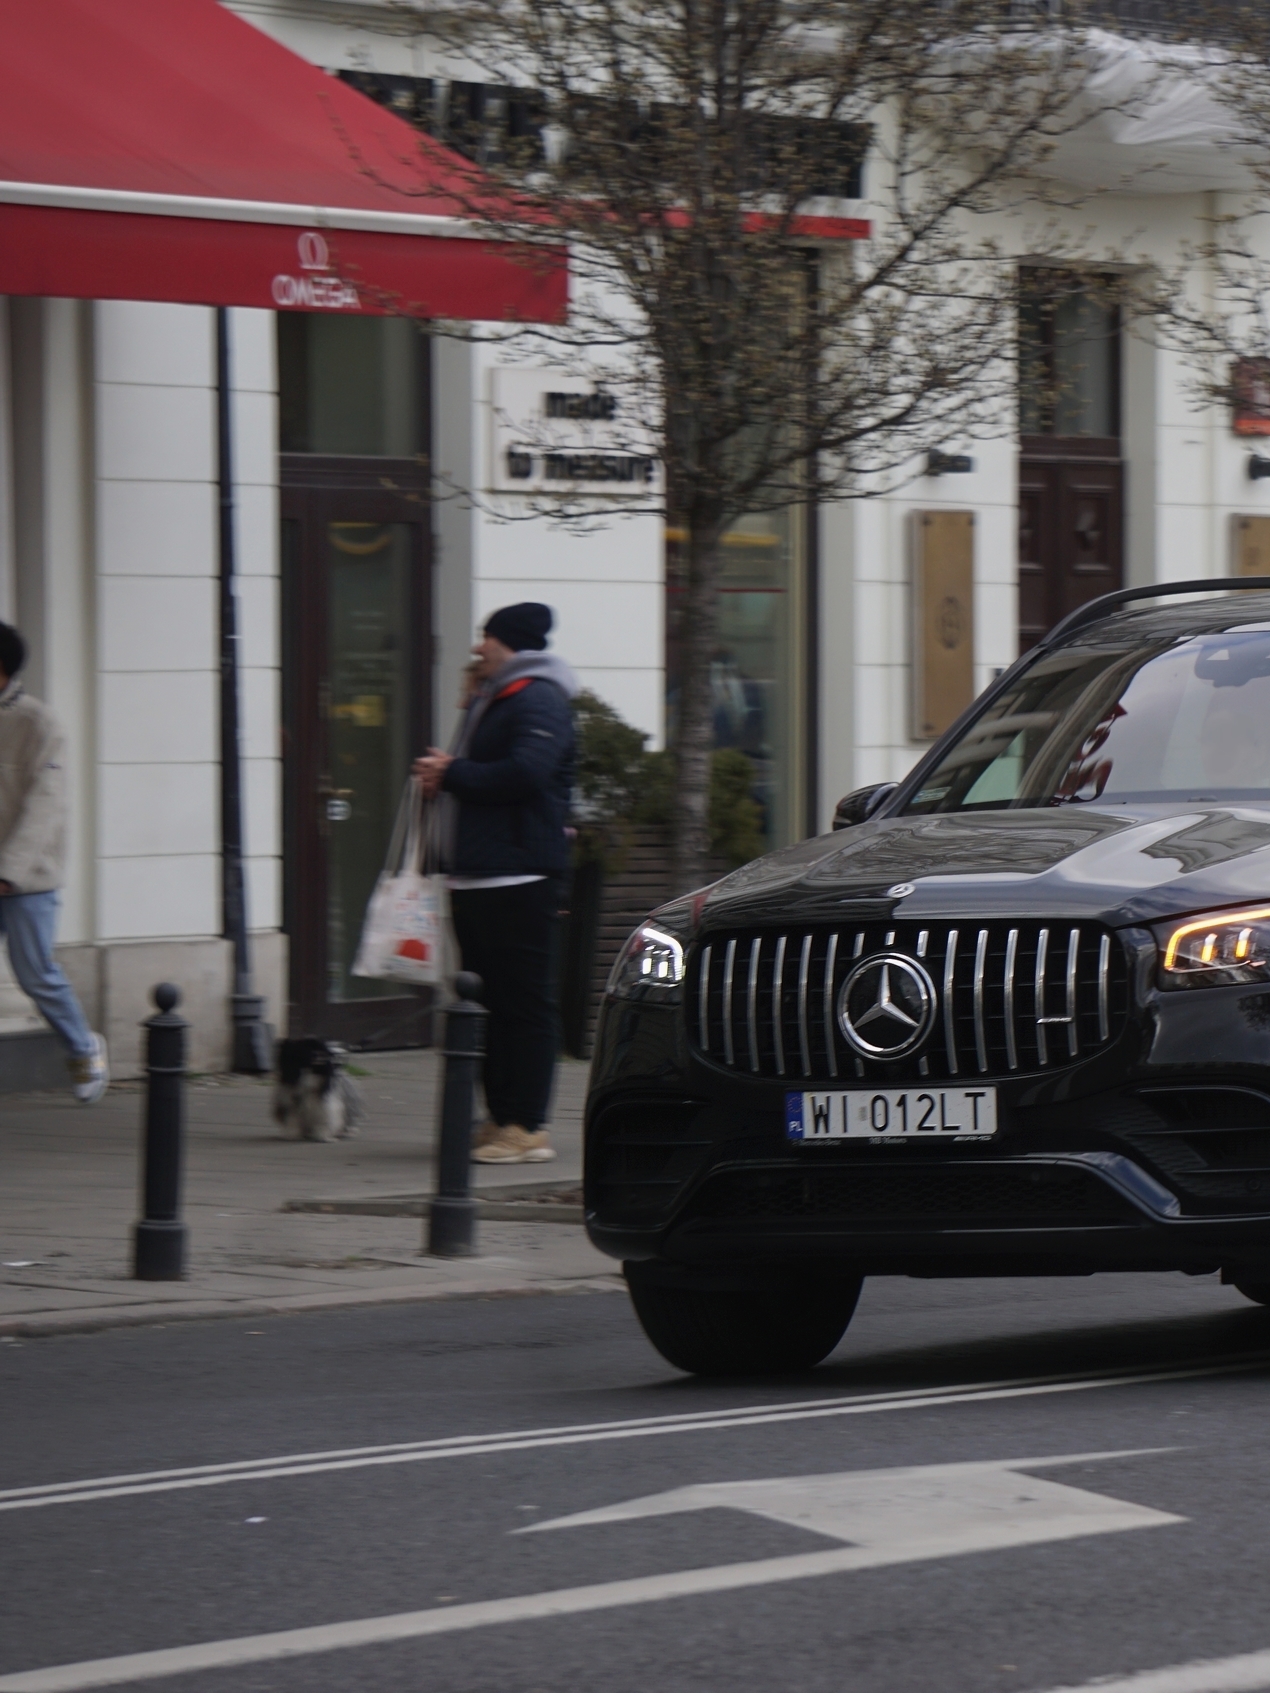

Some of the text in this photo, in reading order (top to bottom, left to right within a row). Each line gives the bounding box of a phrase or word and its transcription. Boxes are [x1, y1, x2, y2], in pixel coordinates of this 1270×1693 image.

[271, 275, 361, 308] OMEGA
[545, 389, 614, 420] made
[508, 448, 653, 482] to measure
[789, 1120, 803, 1132] PL
[811, 1091, 986, 1134] WI 012LT
